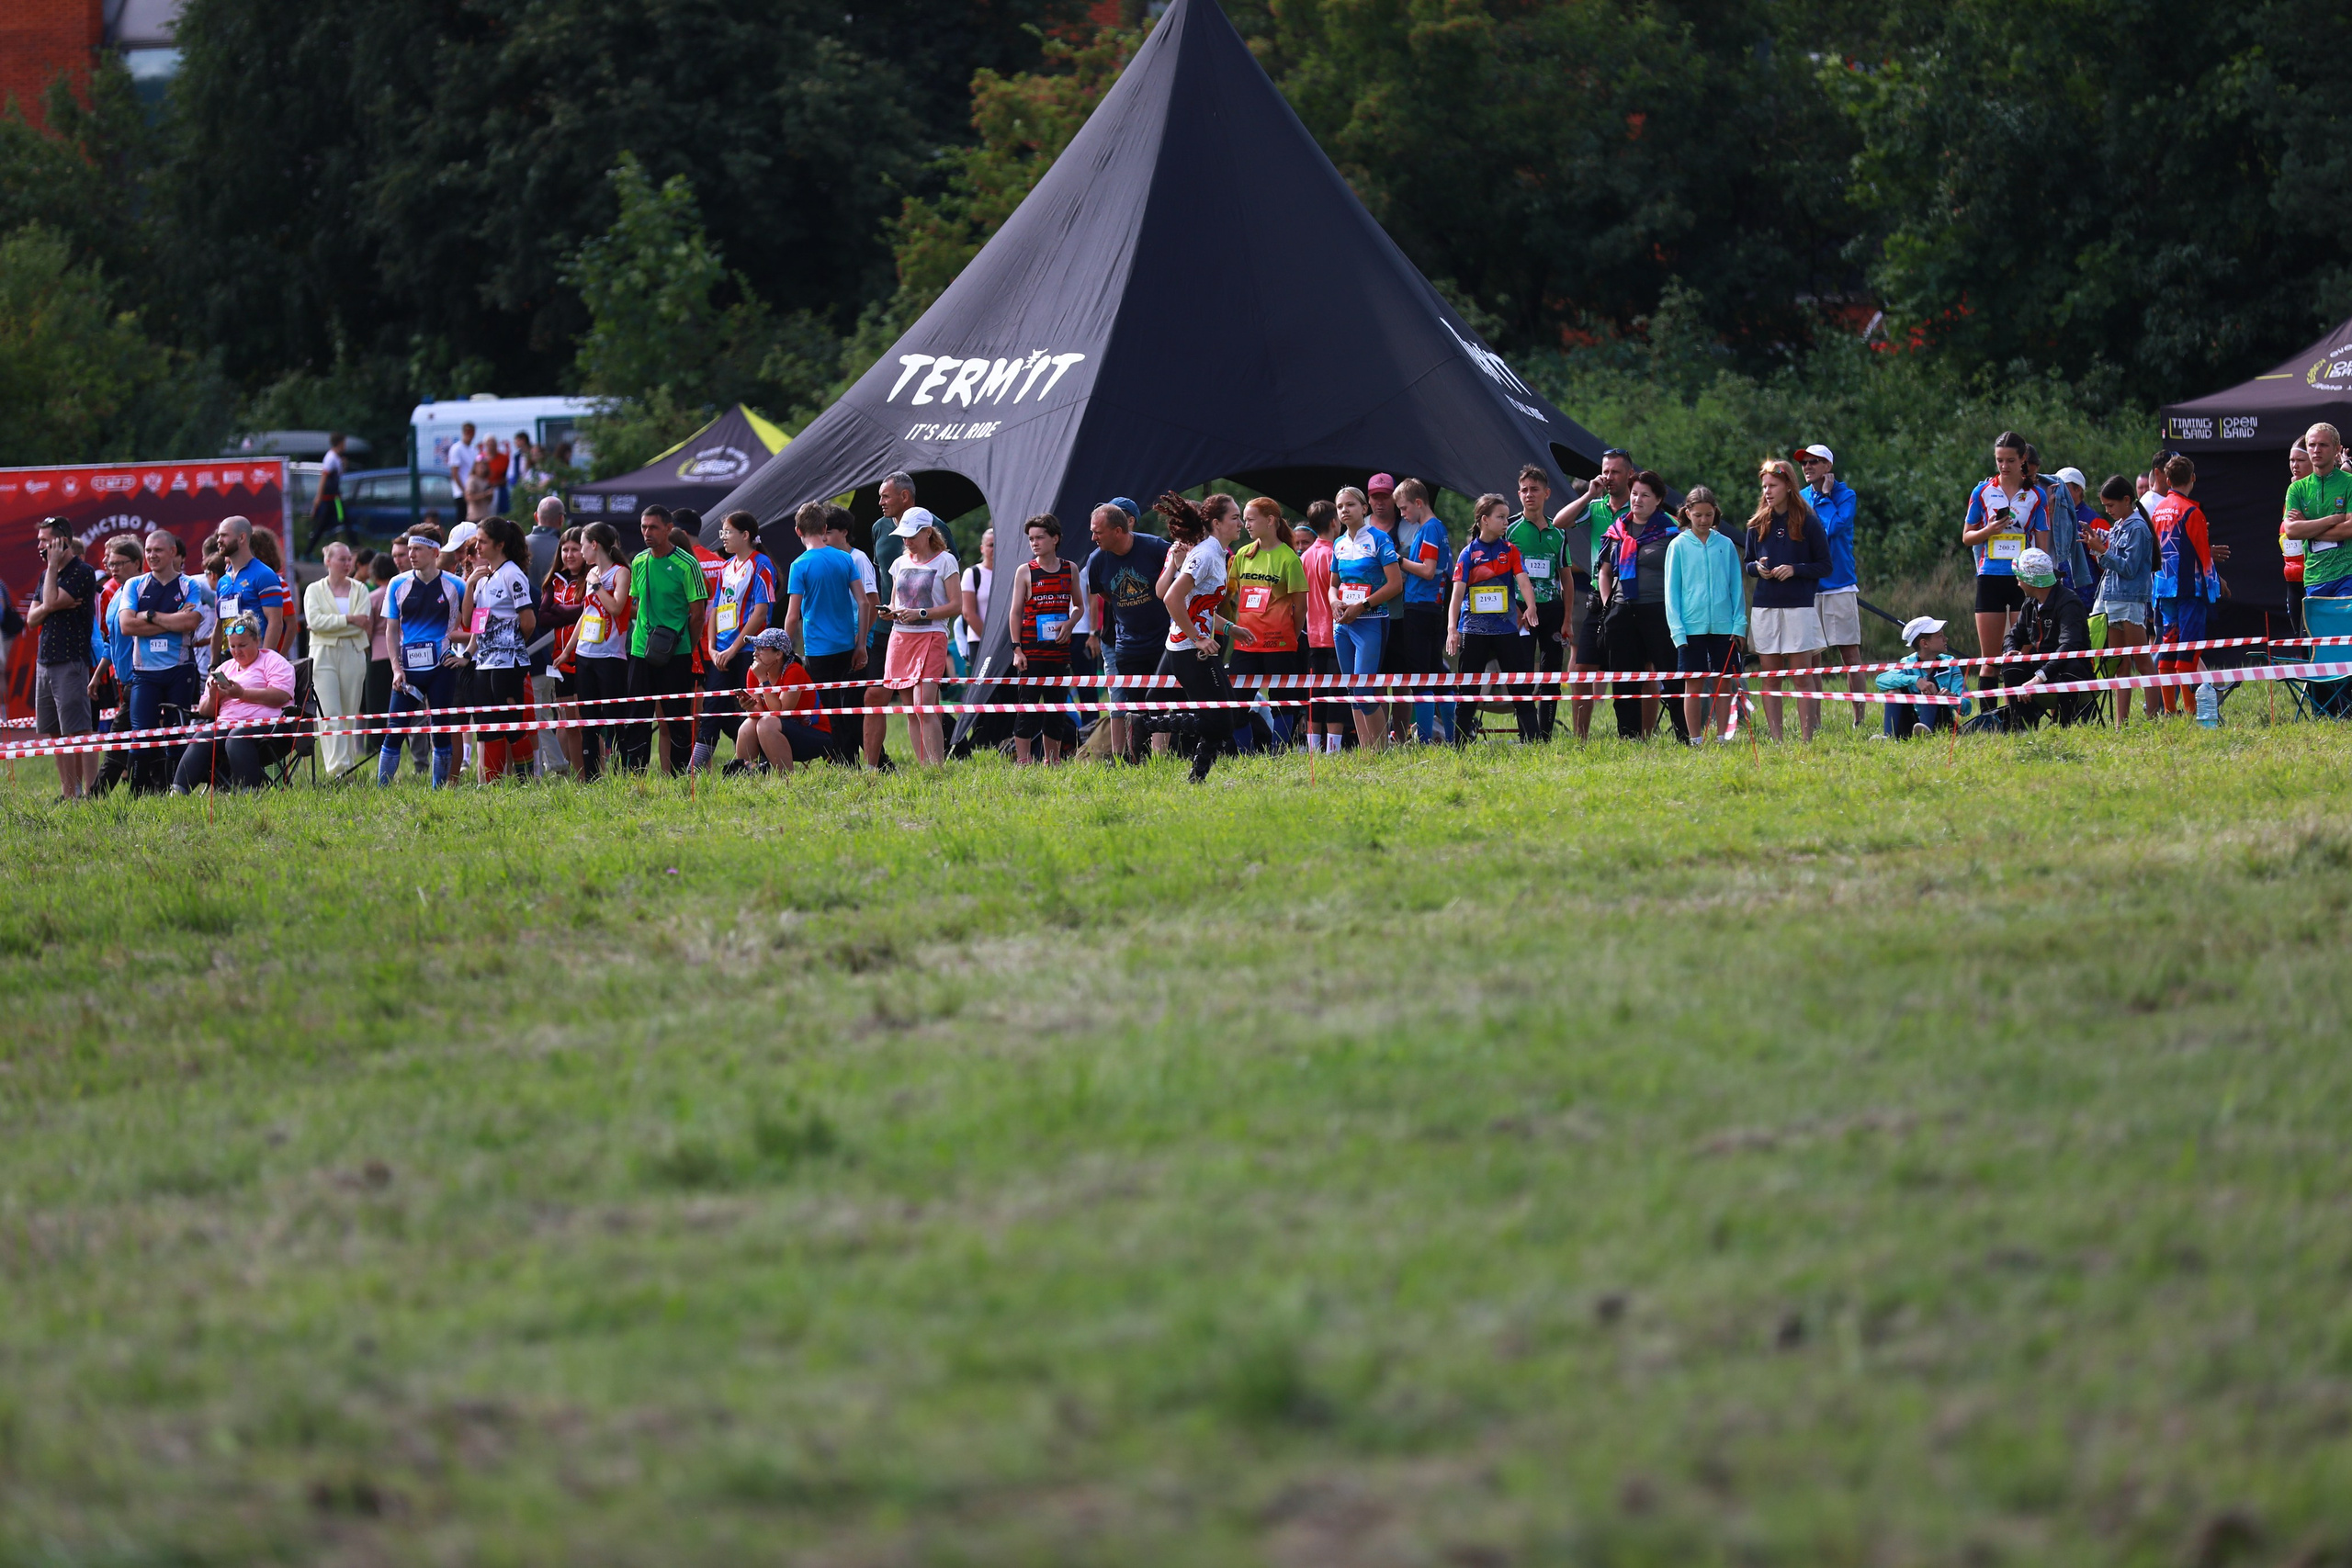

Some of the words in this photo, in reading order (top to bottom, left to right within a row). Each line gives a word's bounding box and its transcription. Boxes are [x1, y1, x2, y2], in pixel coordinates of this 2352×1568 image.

[887, 348, 1086, 408] TERMIT
[904, 423, 940, 441] IT'S
[934, 423, 967, 441] ALL
[963, 420, 1002, 439] RIDE
[2172, 417, 2213, 429] TIMING
[81, 514, 142, 547] ЕНСТВО
